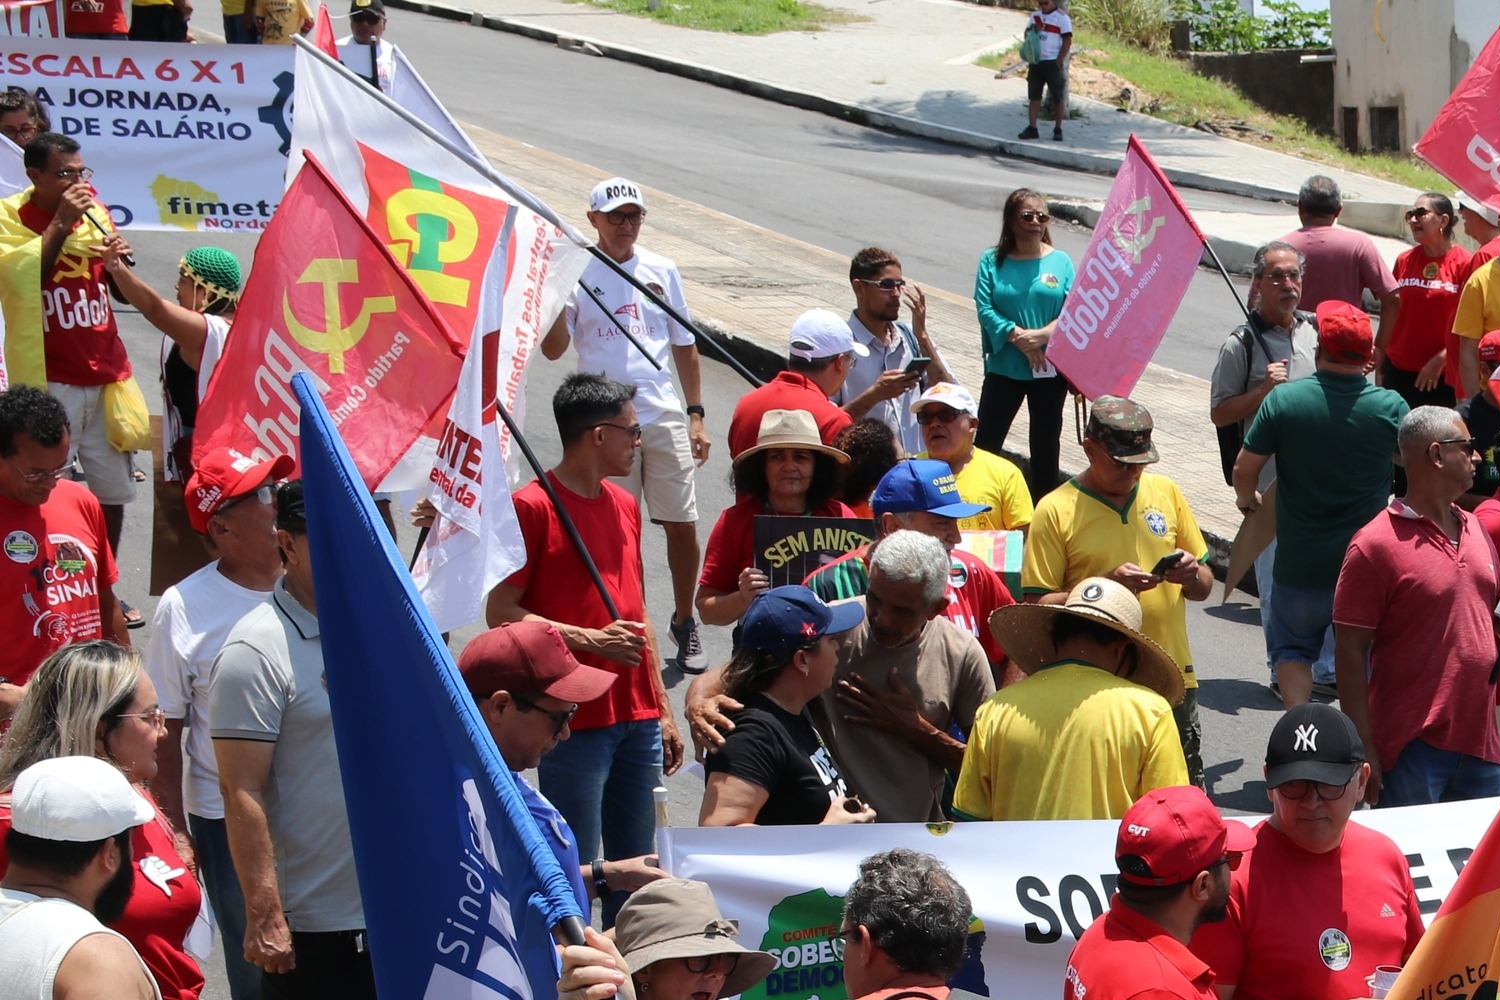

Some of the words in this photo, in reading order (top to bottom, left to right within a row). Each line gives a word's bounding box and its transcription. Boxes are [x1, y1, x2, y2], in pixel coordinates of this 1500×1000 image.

[155, 59, 180, 82] 6
[191, 60, 222, 84] X
[230, 62, 245, 84] 1
[62, 88, 231, 116] JORNADA,
[61, 117, 101, 137] DE
[112, 115, 252, 142] SALÁRIO
[764, 531, 810, 570] SEM
[46, 576, 98, 606] SINAI
[1128, 824, 1150, 837] CUT
[766, 940, 840, 971] SOBE
[766, 964, 844, 997] DEMO
